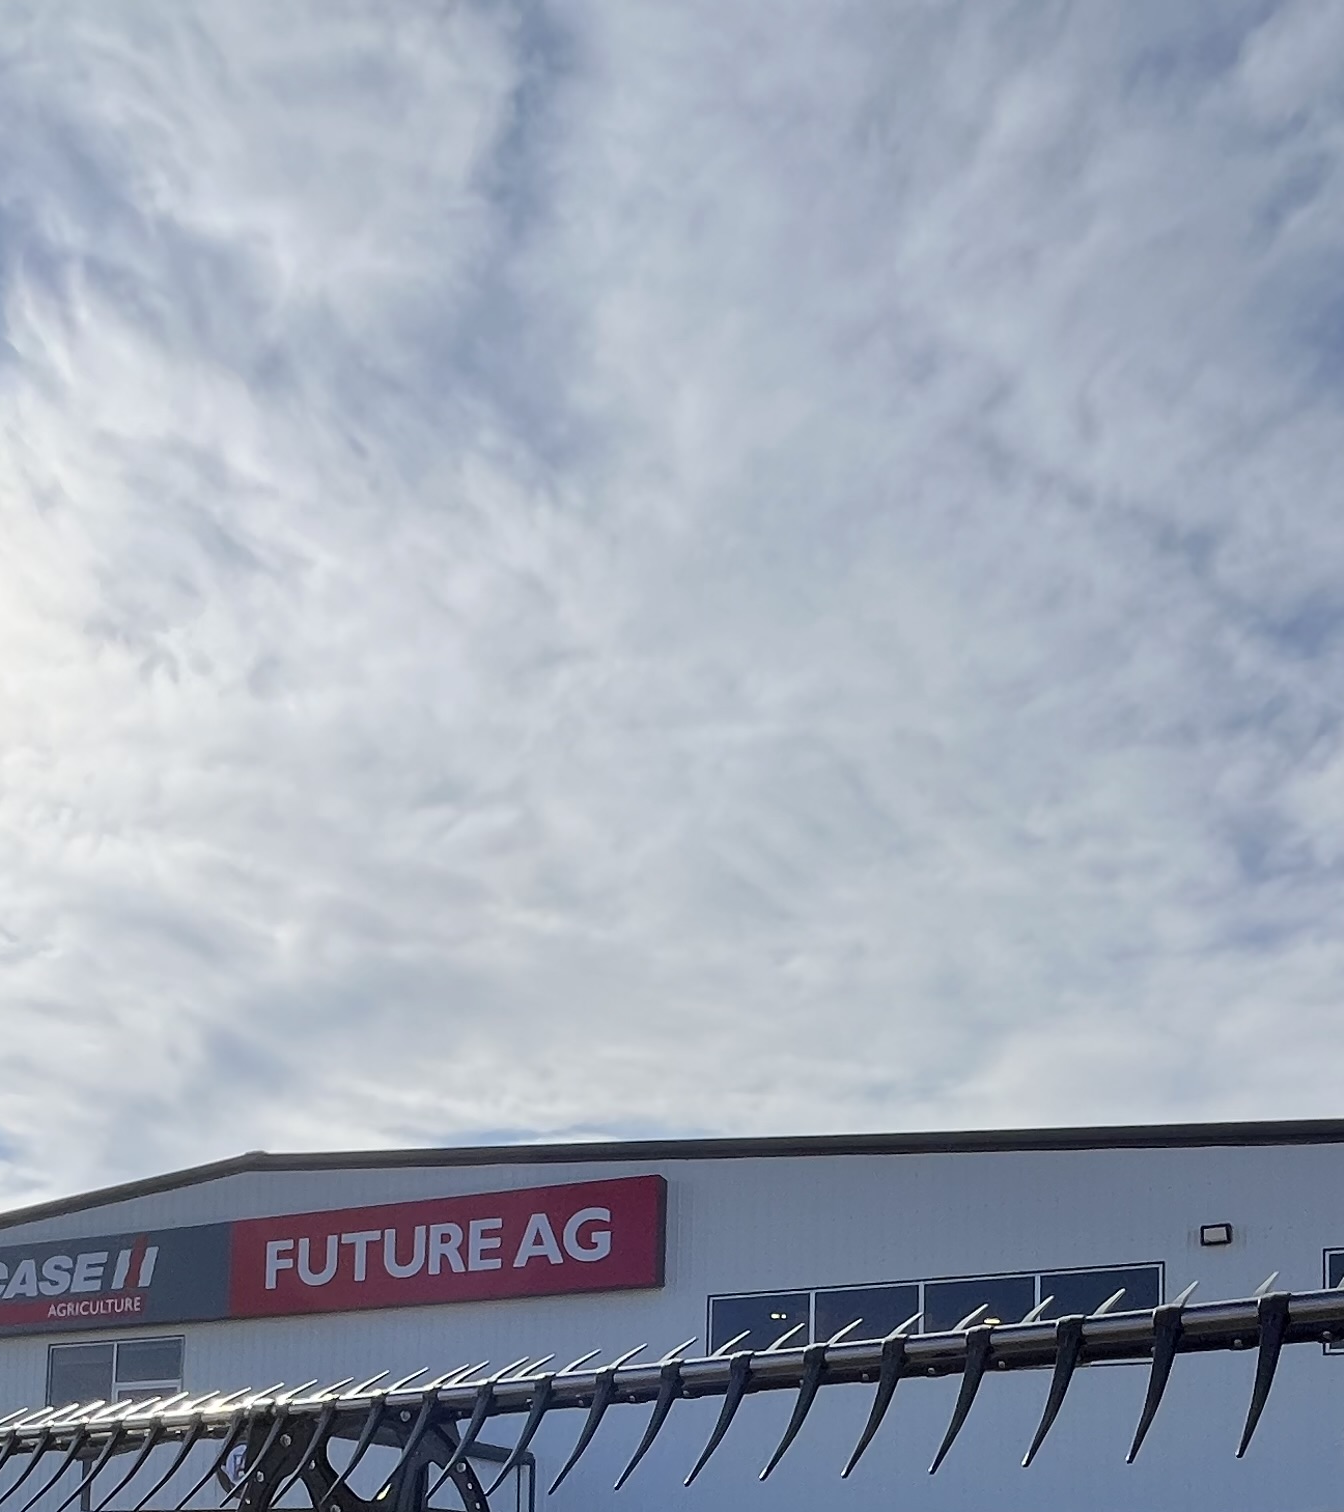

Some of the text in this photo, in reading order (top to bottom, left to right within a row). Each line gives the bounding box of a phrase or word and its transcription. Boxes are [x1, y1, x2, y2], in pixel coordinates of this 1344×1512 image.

[264, 1206, 612, 1290] FUTURE AG
[47, 1296, 142, 1318] AGRICULTURE
